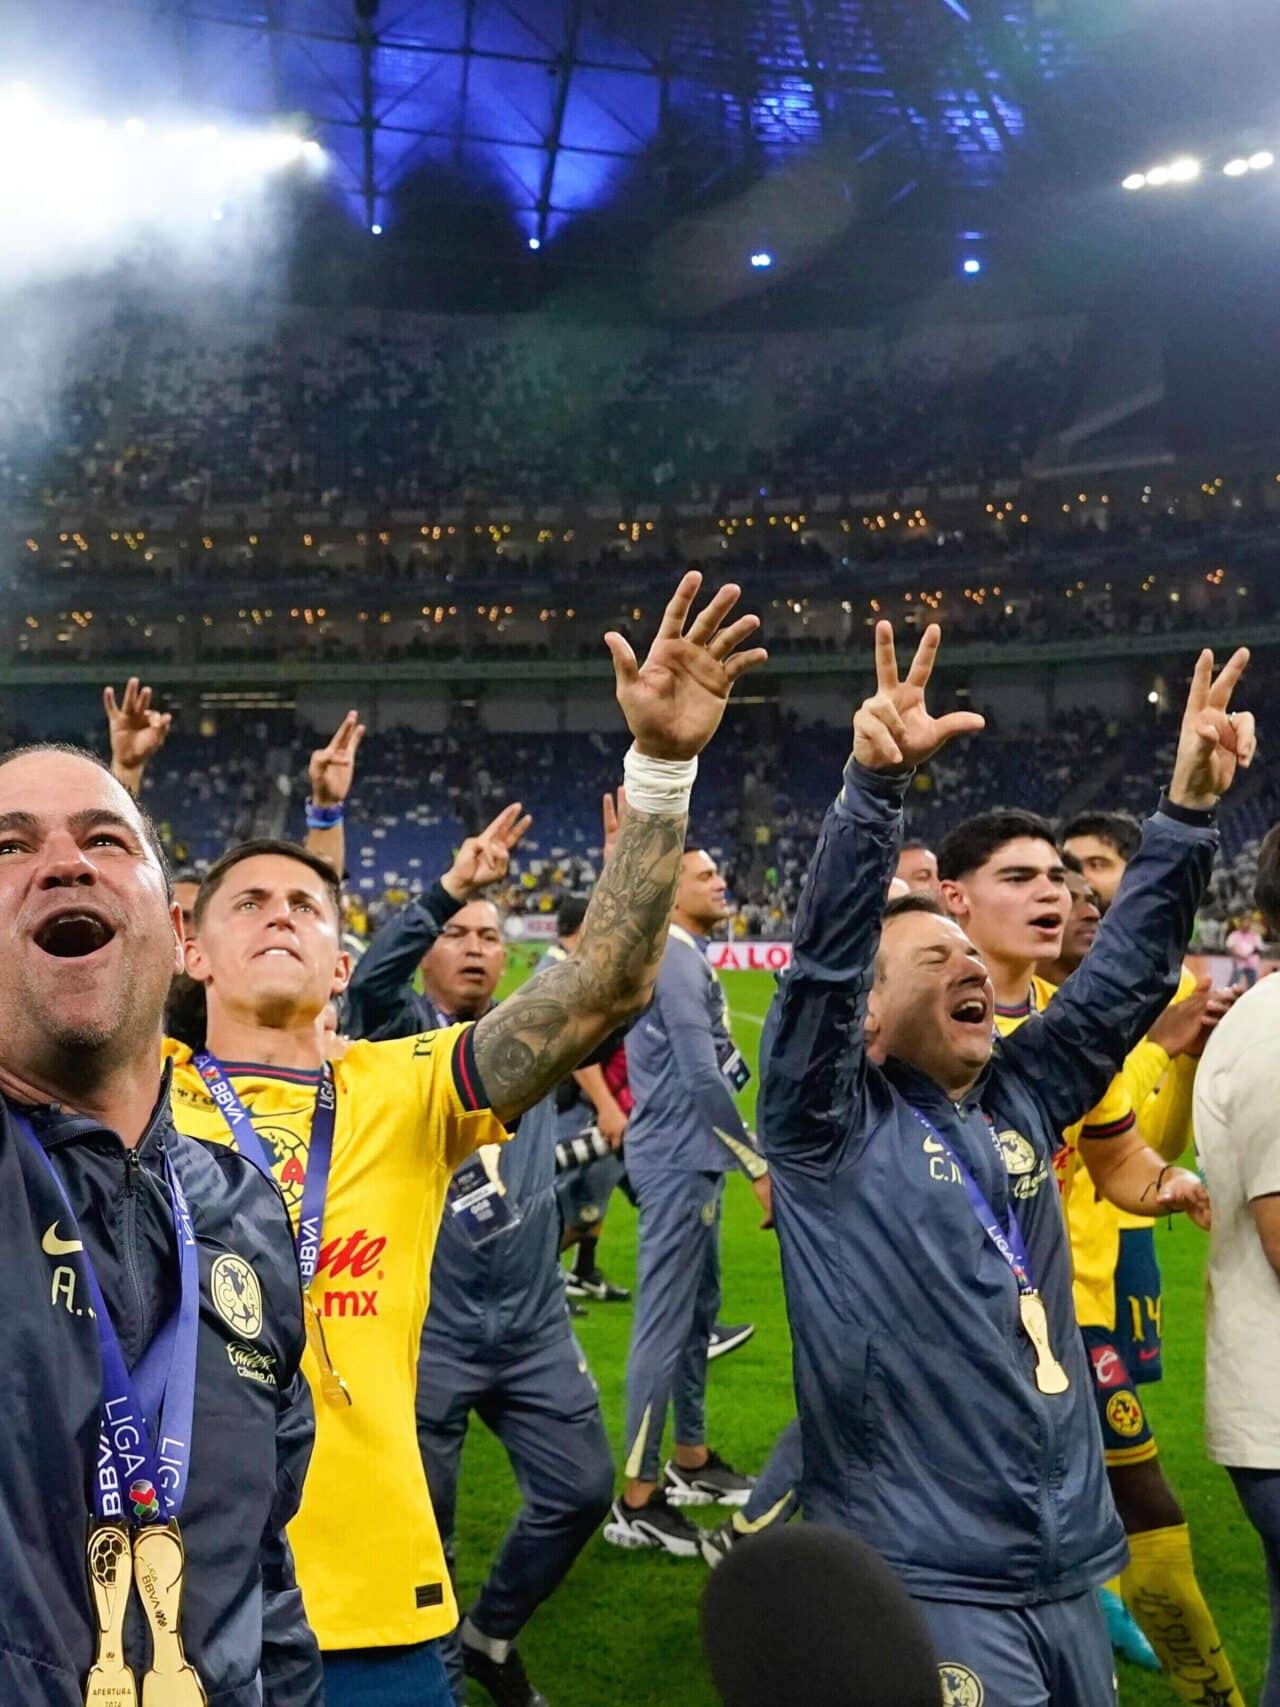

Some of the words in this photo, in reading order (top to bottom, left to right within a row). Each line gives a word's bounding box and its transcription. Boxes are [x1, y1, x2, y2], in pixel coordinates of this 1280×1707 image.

[210, 1081, 245, 1125] BBVA
[319, 1080, 334, 1110] LIGA
[300, 1216, 320, 1277] BBVA
[987, 1225, 1015, 1266] LIGA
[105, 1396, 146, 1478] LIGA
[141, 1575, 161, 1610] BBVA
